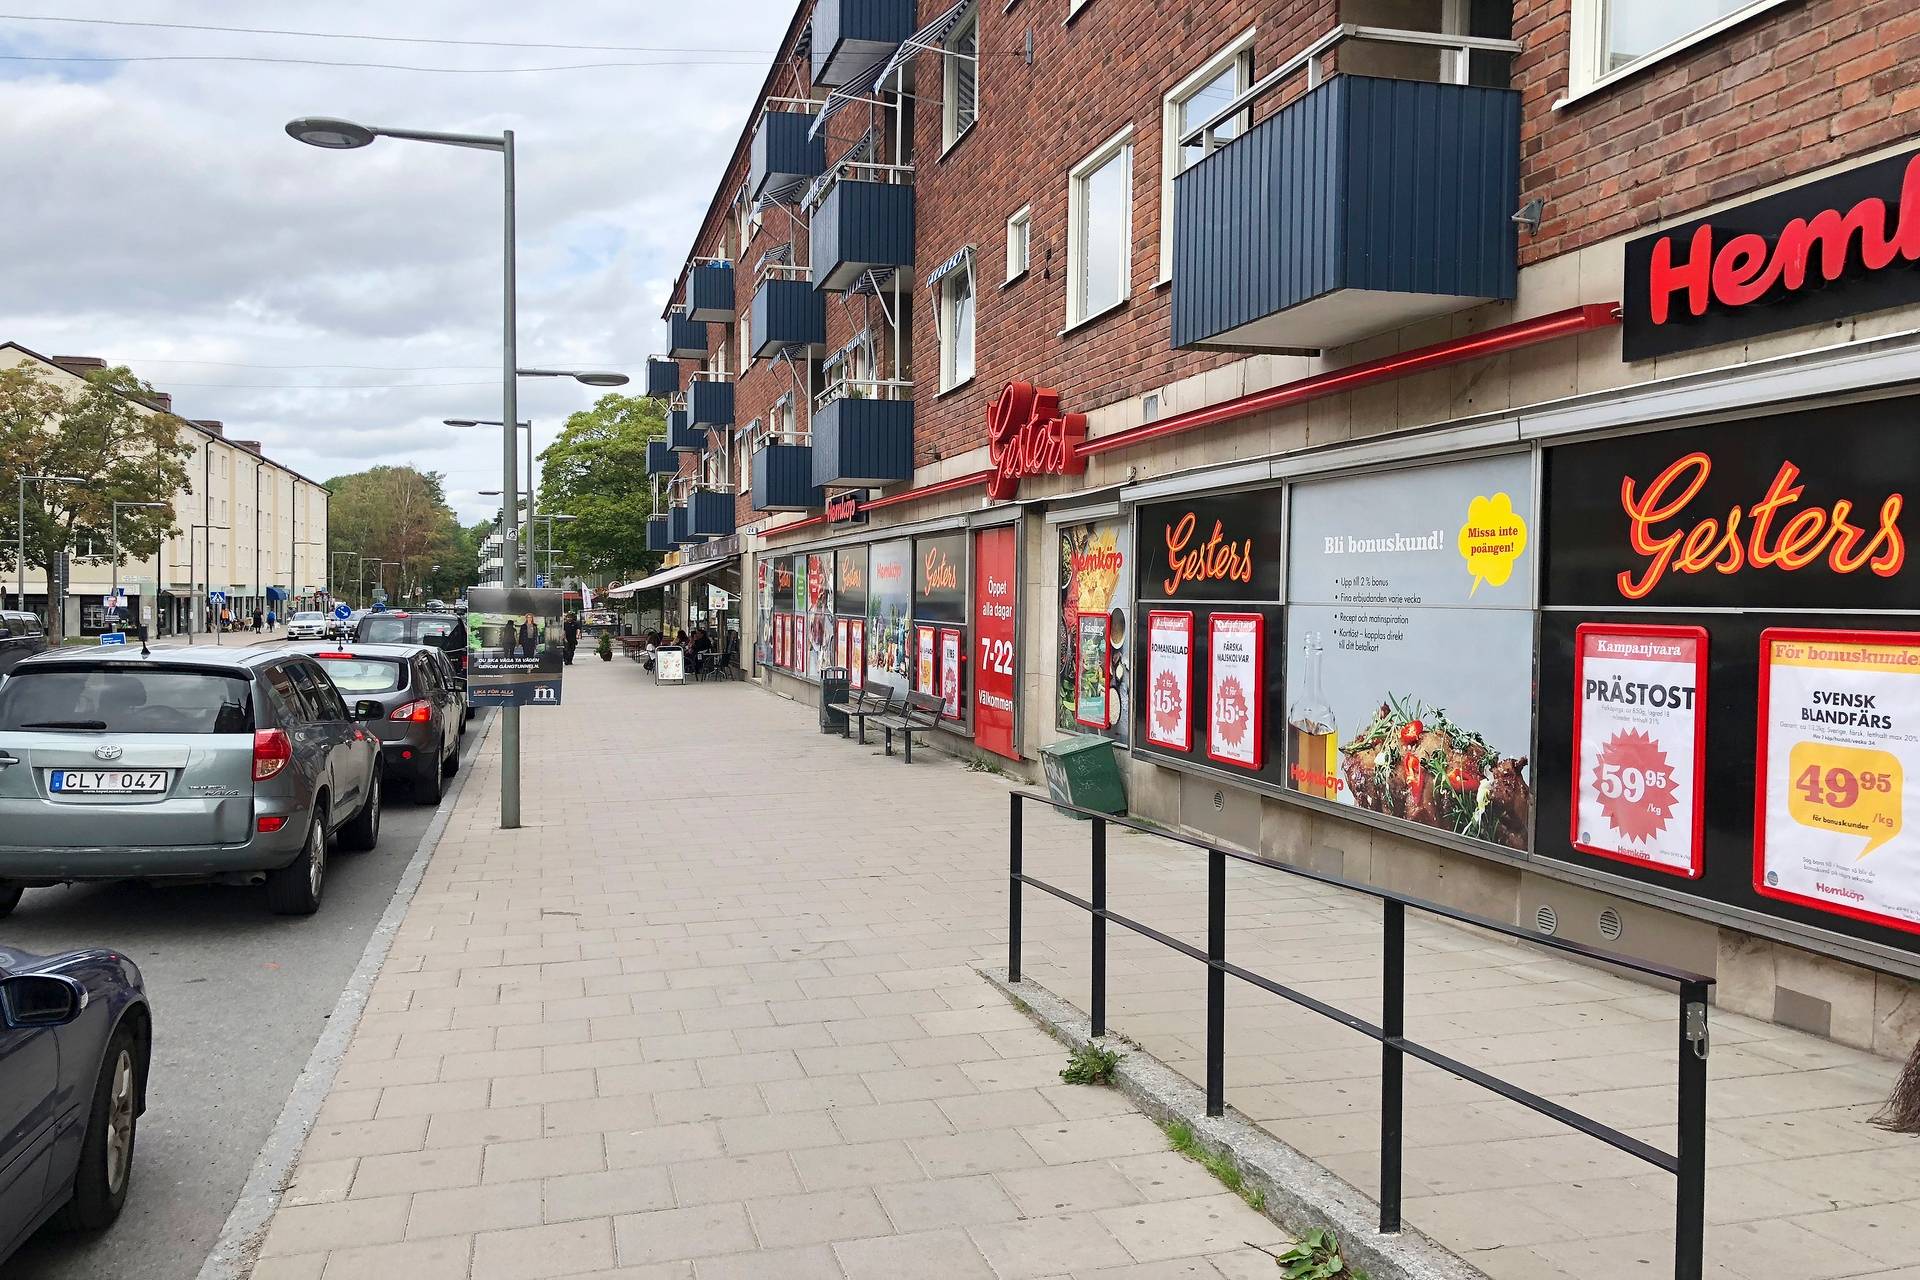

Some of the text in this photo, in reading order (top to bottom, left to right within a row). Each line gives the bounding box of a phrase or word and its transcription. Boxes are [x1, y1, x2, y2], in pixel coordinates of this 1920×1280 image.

[986, 381, 1084, 499] Gesters
[1468, 526, 1518, 538] Missa inte
[1617, 452, 1905, 599] Gesters
[1324, 531, 1444, 554] Bli bonuskund!
[1471, 542, 1514, 556] poängen!
[1071, 546, 1123, 572] Hemköp
[1164, 512, 1252, 596] Gesters
[925, 547, 956, 596] Gesters
[988, 576, 1007, 595] Öppet
[1341, 577, 1352, 588] Upp
[1361, 577, 1364, 586] 2
[1366, 577, 1371, 586] %
[1372, 576, 1388, 586] bonus
[1341, 592, 1421, 607] Fina erbjudanden varje vecka
[982, 603, 1013, 620] alla dagar
[1340, 612, 1408, 626] Recept och matinspiration
[1365, 628, 1385, 641] kopplas
[1387, 629, 1403, 640] direkt
[1346, 640, 1354, 650] ditt
[1355, 641, 1379, 652] betalkort
[1598, 640, 1681, 657] Kampanjvara
[1775, 644, 1804, 659] För
[981, 638, 1013, 675] 7-22
[534, 687, 555, 700] m
[978, 689, 1013, 712] Välkommen
[1586, 675, 1695, 709] PRÄSTOST
[1813, 691, 1876, 709] SVENSK
[1155, 690, 1179, 713] 15:-
[1218, 698, 1244, 723] 15:-
[1802, 708, 1892, 730] BLANDFÄRS
[65, 773, 161, 788] CLY 047
[1290, 762, 1344, 793] Hemköp
[1647, 803, 1662, 816] /kg
[1812, 814, 1869, 830] för bonuskunder
[1872, 813, 1893, 828] /kg
[1816, 882, 1864, 902] Hemköp
